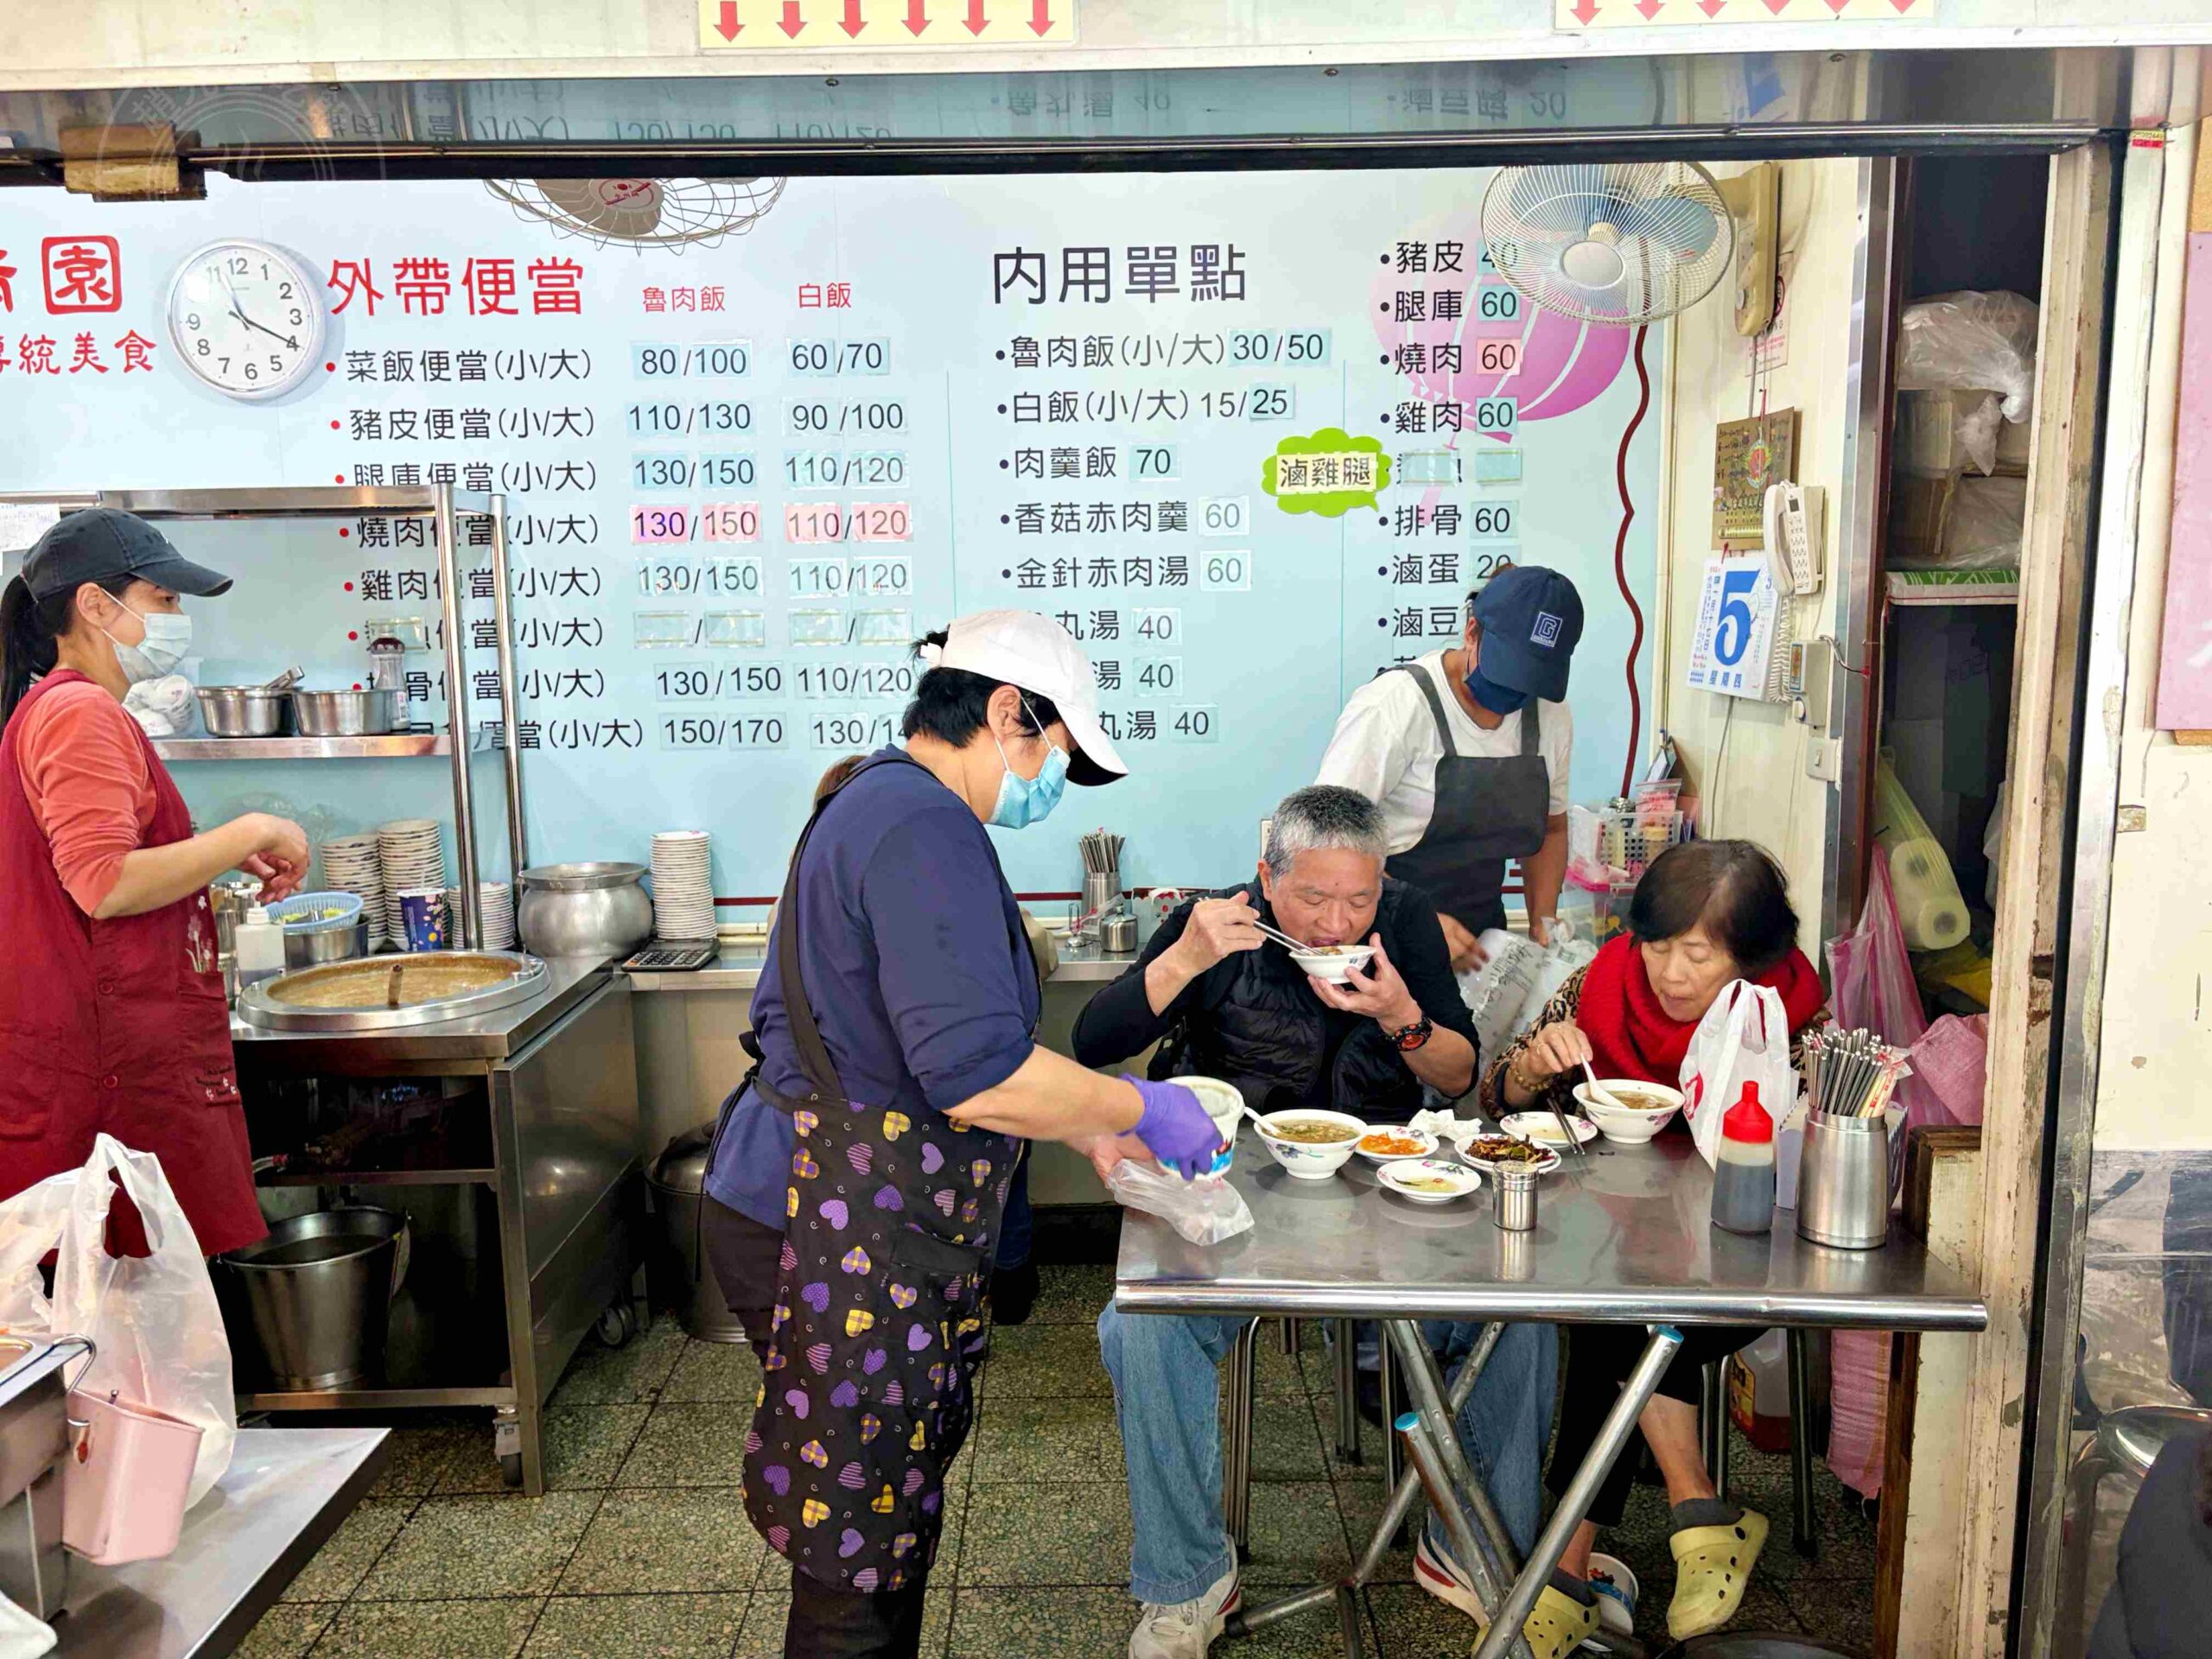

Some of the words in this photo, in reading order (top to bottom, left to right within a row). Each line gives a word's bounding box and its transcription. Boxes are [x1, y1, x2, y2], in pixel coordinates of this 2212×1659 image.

[227, 258, 249, 275] 12
[261, 264, 268, 280] 1
[1396, 240, 1464, 274] 豬皮
[207, 266, 221, 282] 11
[327, 257, 584, 317] 外帶便當
[279, 283, 293, 299] 2
[642, 286, 725, 313] 魯肉飯
[798, 283, 851, 308] 白飯
[1395, 289, 1463, 322] 腿庫
[1481, 291, 1516, 317] 60
[188, 314, 200, 330] 9
[289, 308, 302, 325] 3
[0, 329, 157, 375] 統美食
[197, 339, 210, 356] 8
[346, 348, 592, 383] 菜飯便當(小/大)
[641, 347, 747, 376] 80/100
[792, 343, 882, 373] 60/70
[1010, 332, 1225, 368] 魯肉飯(小/大)
[1233, 334, 1323, 361] 30/50
[1395, 343, 1462, 374] 燒肉
[1481, 344, 1516, 369] 60
[218, 358, 230, 373] 7
[245, 363, 257, 379] 6
[270, 355, 283, 372] 5
[1013, 388, 1189, 423] 白飯(小/大)
[1200, 389, 1287, 419] 15/25
[1395, 402, 1462, 434] 雞肉
[1478, 402, 1513, 429] 60
[350, 406, 595, 442] 豬皮便當(小/大)
[629, 404, 751, 433] 110/130
[792, 404, 903, 431] 90/100
[635, 458, 754, 487] 130/150
[785, 456, 904, 486] 110/120
[1014, 446, 1116, 480] 肉羹飯
[1135, 449, 1172, 474] 70
[1280, 456, 1370, 487] 滷雞腿
[633, 511, 757, 541] 130/150
[788, 509, 906, 539] 110/120
[1014, 500, 1189, 534] 香菇赤肉羹
[1205, 502, 1241, 528] 60
[1395, 504, 1462, 537] 排骨
[1475, 508, 1510, 532] 60
[639, 565, 759, 594] 130/150
[790, 563, 906, 593] 110/120
[1017, 556, 1189, 589] 金針赤肉湯
[1207, 557, 1242, 583] 60
[1392, 554, 1459, 585] 滷蛋
[1035, 610, 1119, 641] 丸湯
[1138, 614, 1173, 639] 40
[1392, 606, 1470, 638] 滷豆
[1715, 569, 1760, 667] 5
[366, 668, 604, 702] 骨當小/大)
[657, 666, 781, 696] 130/150
[797, 666, 912, 695] 110/120
[1092, 660, 1121, 690] 湯
[1139, 664, 1173, 689] 40
[664, 718, 782, 746] 150/170
[813, 718, 905, 745] 130/1
[1098, 709, 1156, 741] 丸湯
[1174, 710, 1210, 735] 40
